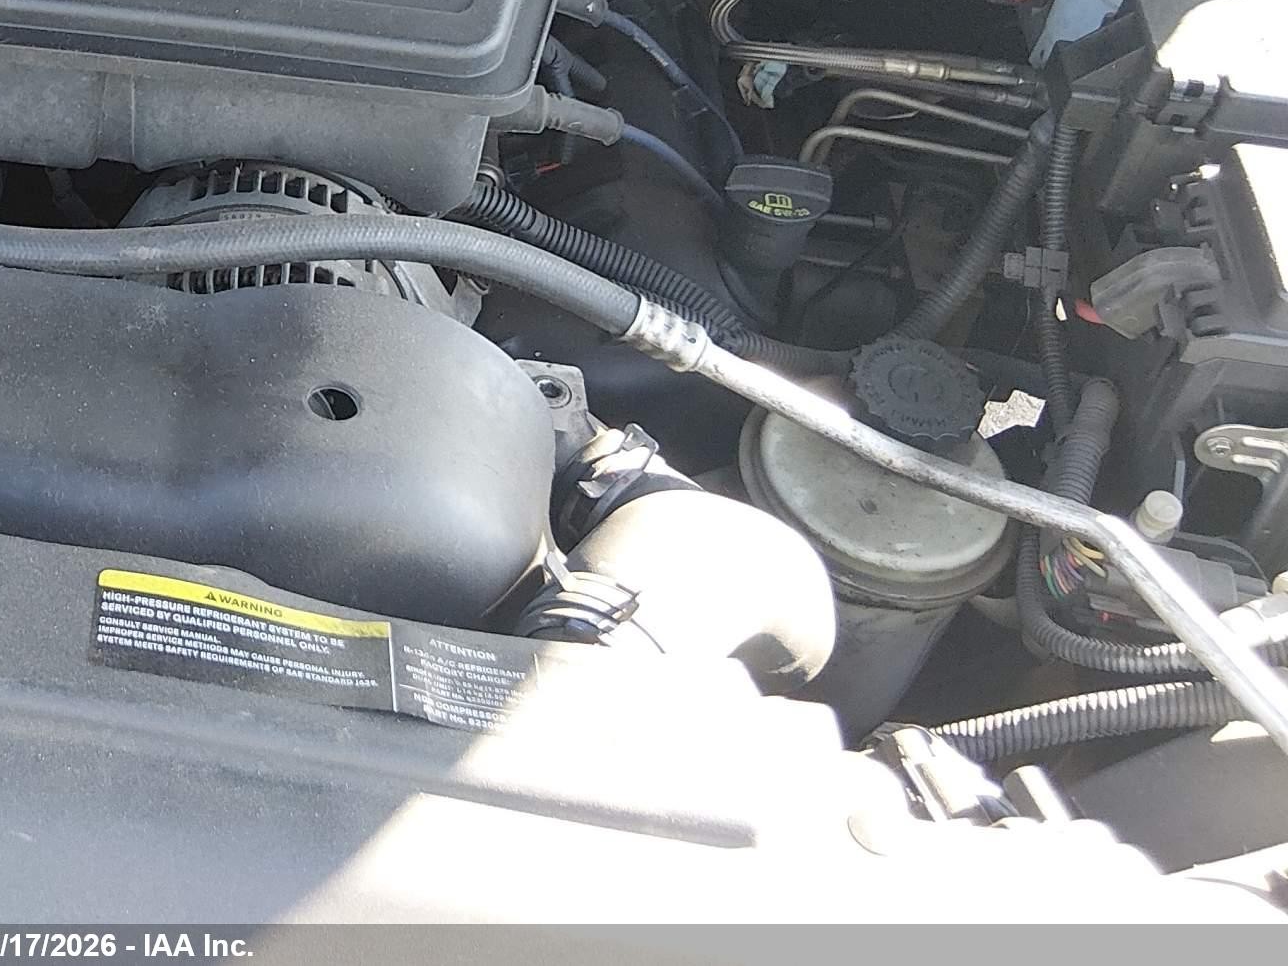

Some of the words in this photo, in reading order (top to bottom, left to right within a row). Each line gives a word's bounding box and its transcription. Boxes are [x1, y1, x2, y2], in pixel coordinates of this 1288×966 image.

[102, 590, 191, 614] HIGH-PRESSURE
[192, 606, 266, 629] REFRIGERANT
[268, 623, 311, 640] SYSTEM
[313, 634, 328, 644] TO
[329, 638, 345, 647] BE
[218, 594, 283, 618] WARNING
[99, 616, 141, 628] CONSULT
[142, 622, 179, 635] SERVICE
[180, 629, 222, 644] MANUAL.
[100, 601, 154, 617] SERVICED
[156, 610, 171, 621] BY
[172, 613, 231, 632] QUALIFIED
[232, 626, 297, 647] PERSONNEL
[299, 642, 330, 654] ONLY.
[97, 634, 132, 646] SYSTEM
[133, 640, 164, 652] MEETS
[165, 645, 199, 659] SAFETY
[200, 651, 270, 672] REQUIREMENTS
[271, 665, 284, 674] OF
[285, 669, 304, 678] SAE
[305, 671, 353, 686] STANDARD
[98, 625, 145, 639] IMPROPER
[145, 633, 183, 645] SERVICE
[184, 639, 229, 654] METHODS
[230, 647, 250, 659] MAY
[251, 653, 281, 665] CAUSE
[282, 658, 329, 674] PERSONAL
[429, 638, 496, 662] ATTENTION
[420, 658, 464, 677] FACTORY
[437, 657, 456, 667] A/C
[457, 662, 526, 680] REFRIGERANT
